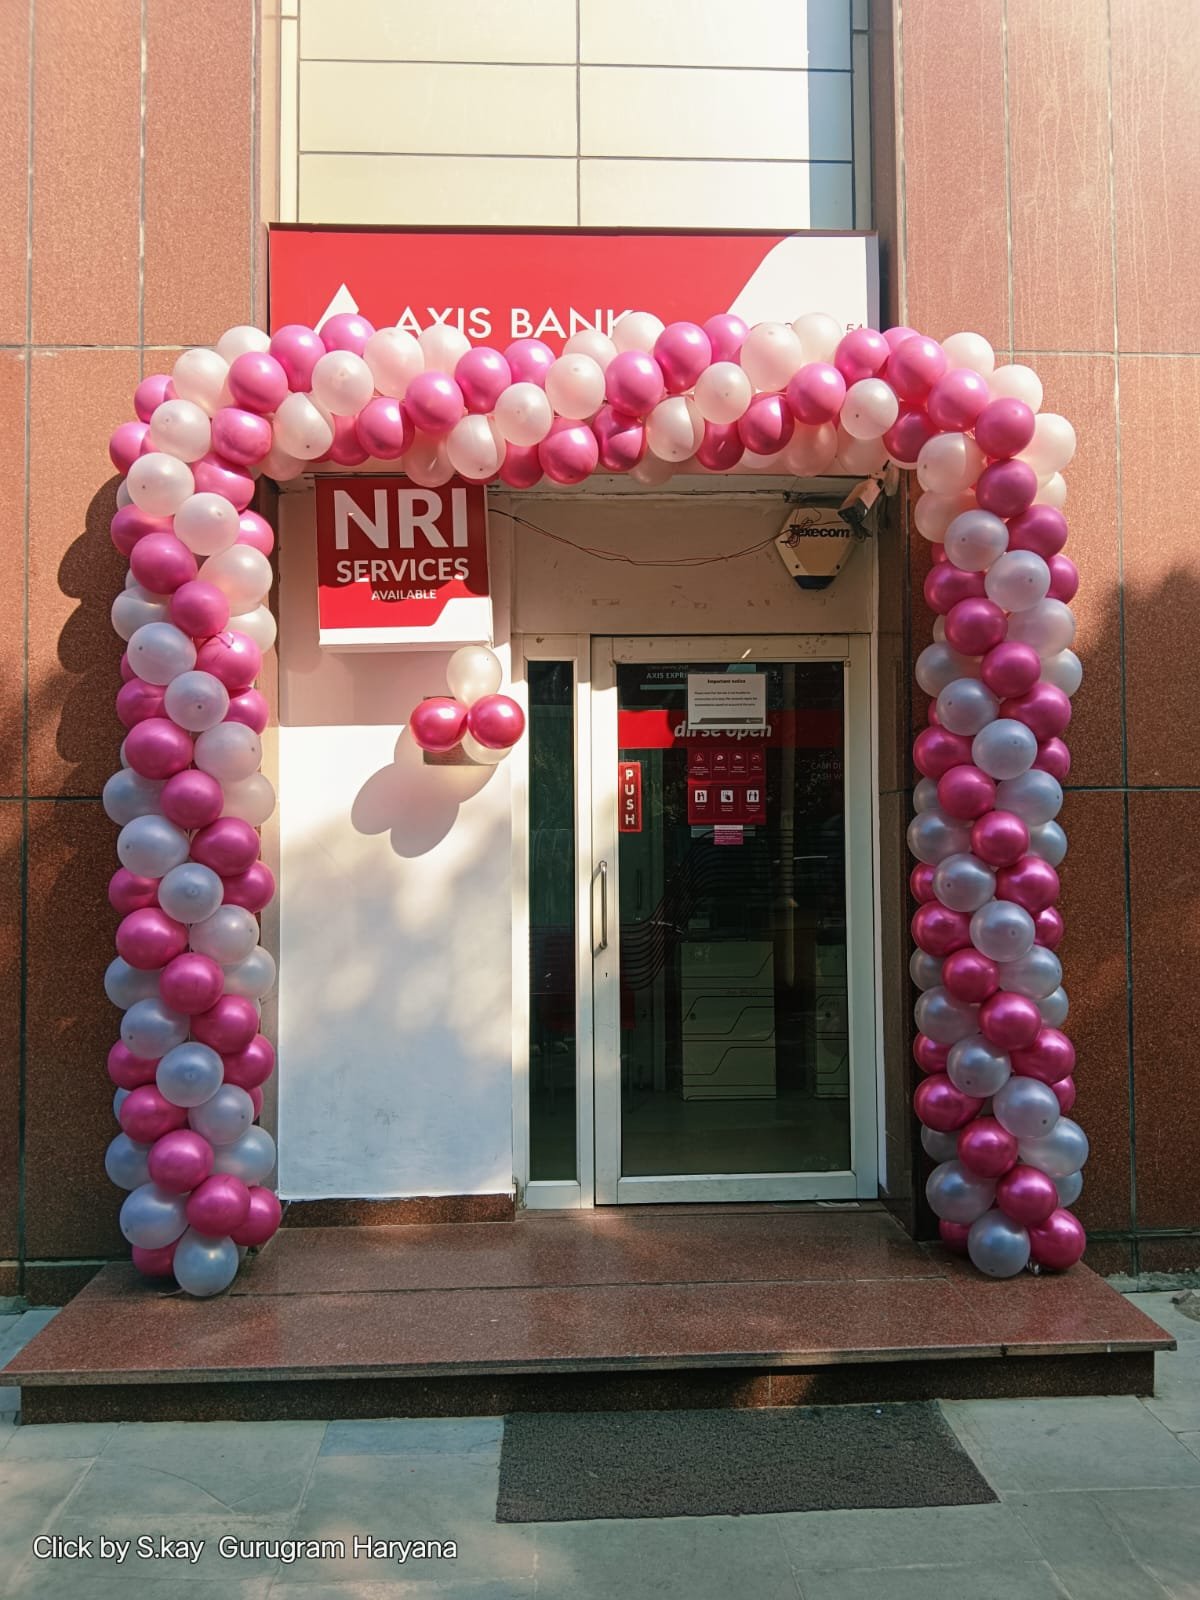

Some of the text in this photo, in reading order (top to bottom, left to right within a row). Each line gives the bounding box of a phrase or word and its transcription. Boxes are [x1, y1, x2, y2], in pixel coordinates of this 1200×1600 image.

[395, 305, 633, 339] AXIS BANK
[333, 488, 468, 550] NRI
[336, 558, 470, 583] SERVICES
[371, 589, 437, 601] AVAILABLE
[625, 769, 635, 825] PUSH
